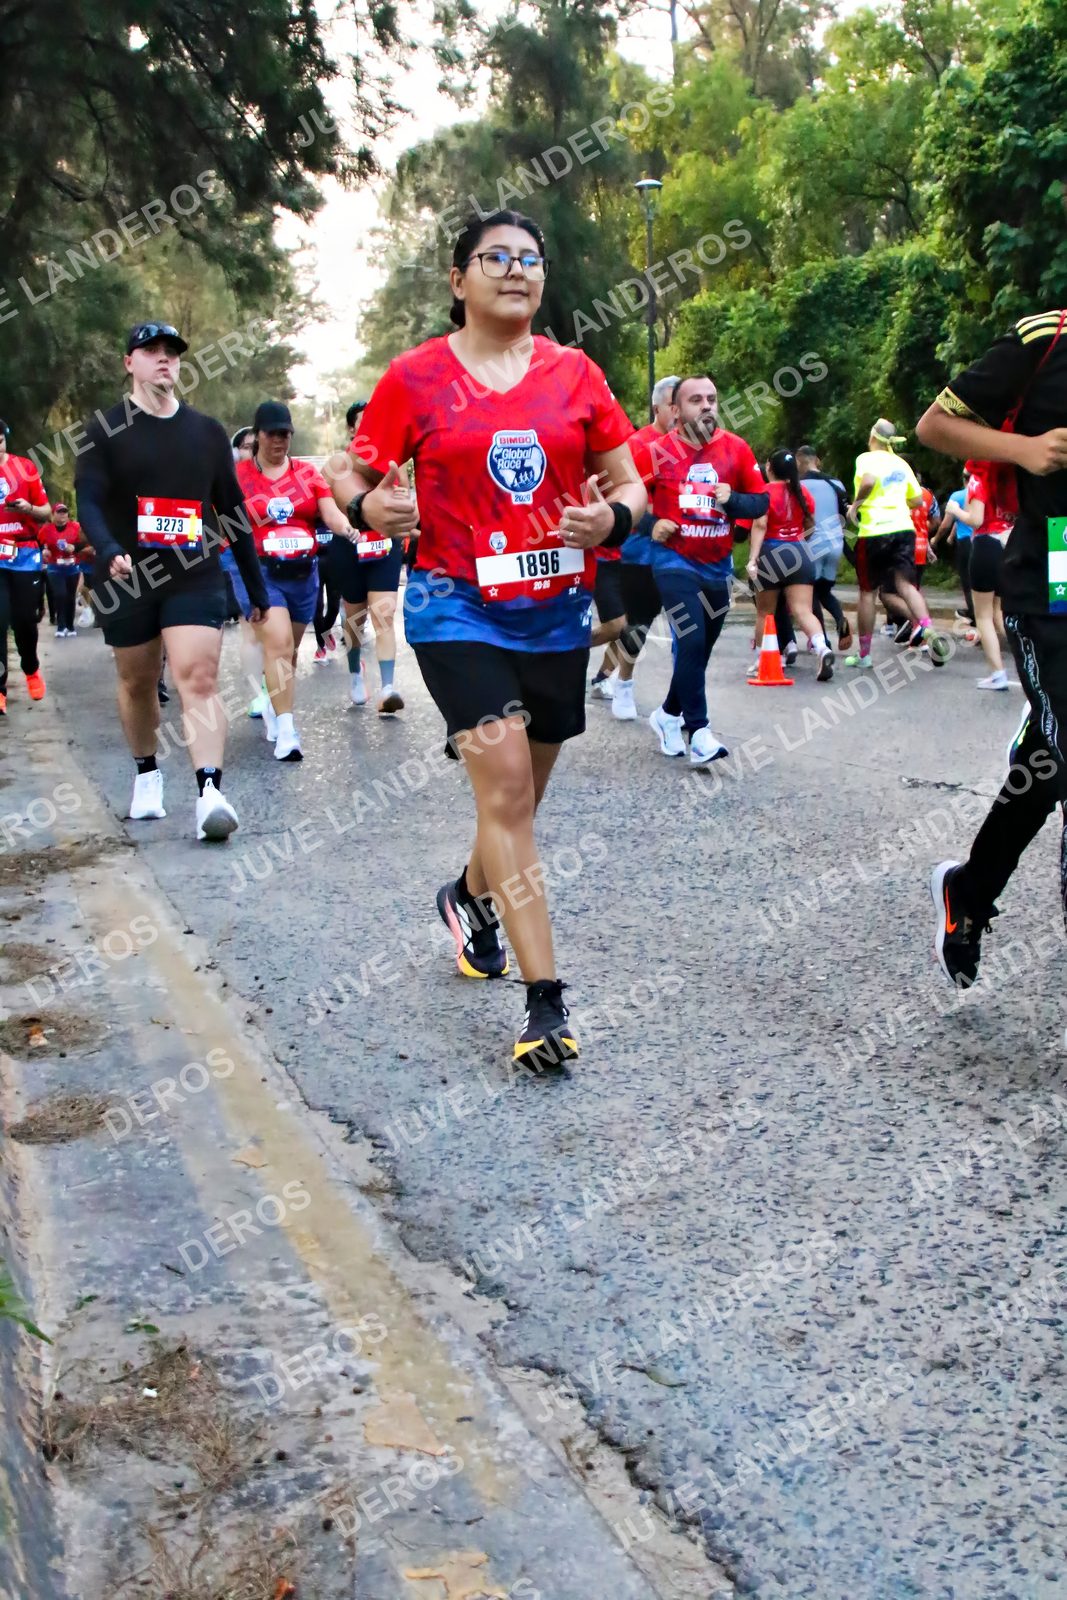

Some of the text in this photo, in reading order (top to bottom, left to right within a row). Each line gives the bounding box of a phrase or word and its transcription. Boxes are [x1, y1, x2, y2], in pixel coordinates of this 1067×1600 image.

[499, 436, 532, 444] BIMBO
[501, 447, 532, 460] Global
[497, 458, 522, 470] Race
[696, 495, 716, 509] 3119
[156, 517, 184, 533] 3273
[278, 539, 299, 549] 3613
[516, 550, 560, 578] 1896
